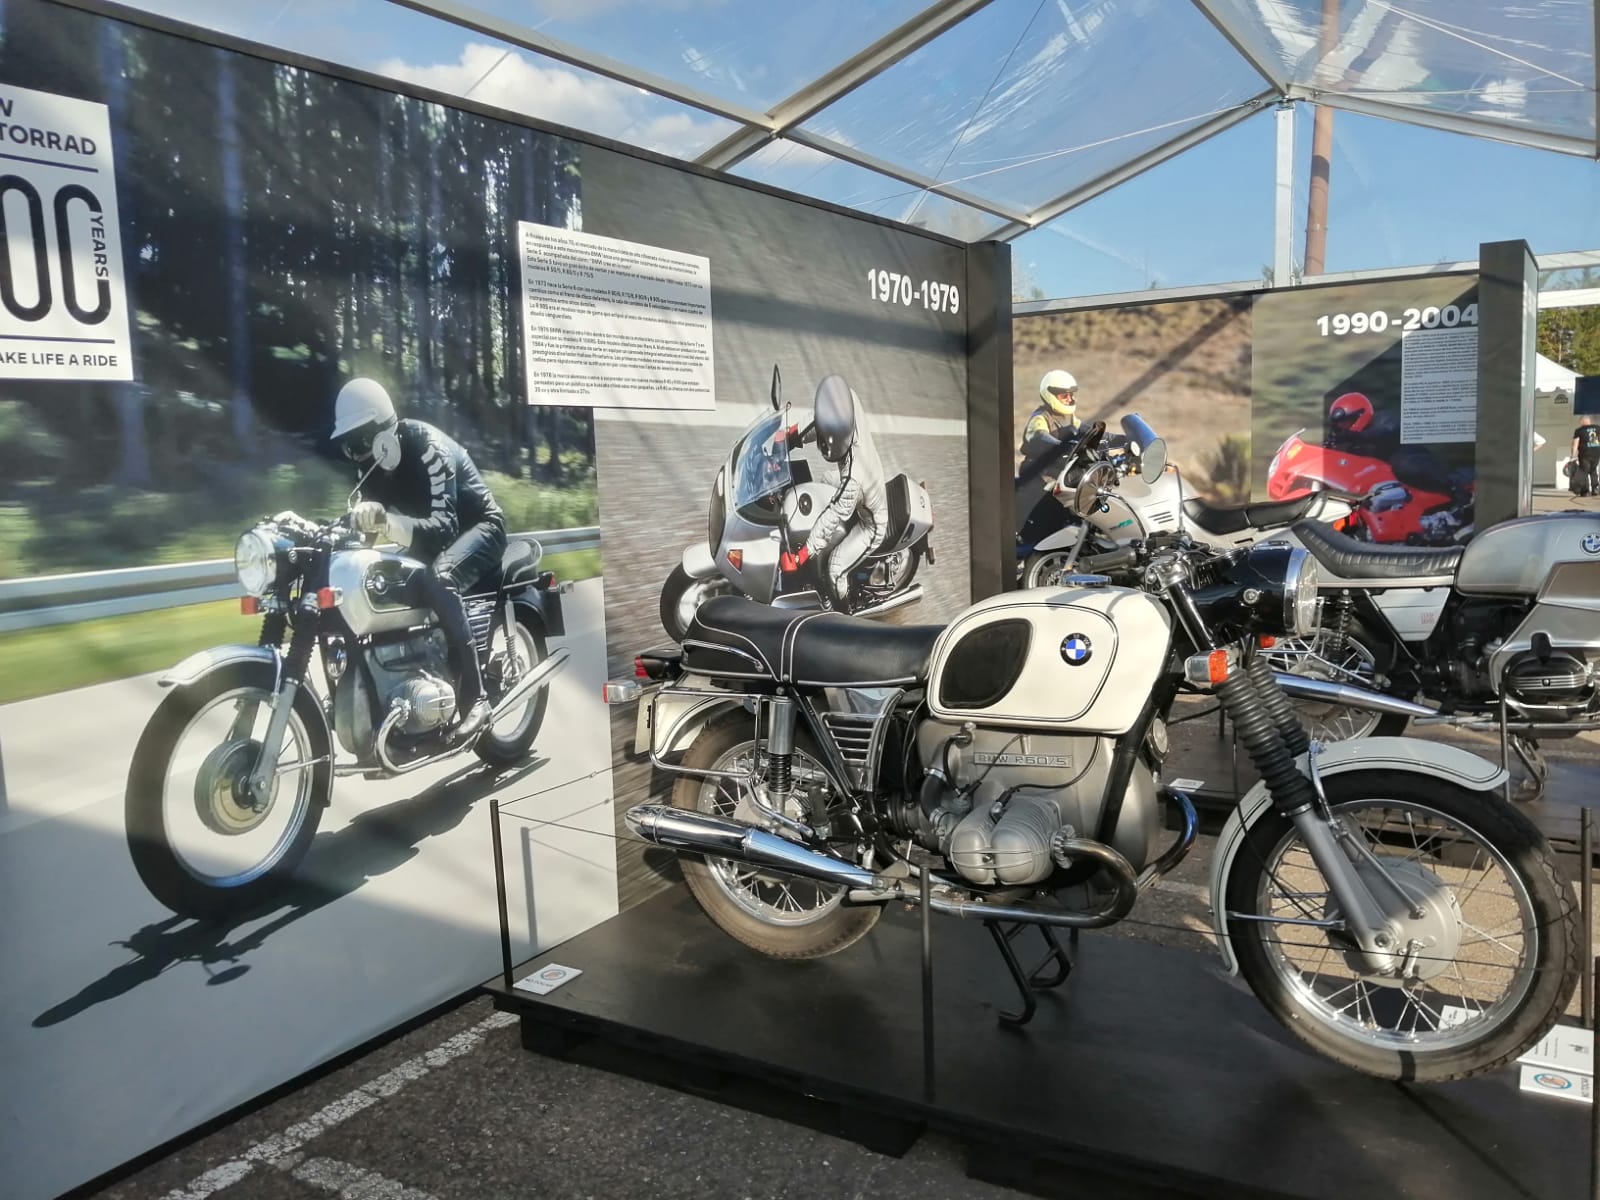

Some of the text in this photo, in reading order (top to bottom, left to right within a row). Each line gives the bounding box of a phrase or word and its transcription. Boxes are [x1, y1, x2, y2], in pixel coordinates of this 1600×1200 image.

[90, 215, 109, 278] YEARS
[868, 268, 960, 314] 1970-1979
[1317, 303, 1479, 336] 1990-2004
[32, 353, 65, 365] LIFE
[69, 354, 79, 366] A
[83, 355, 117, 367] RIDE
